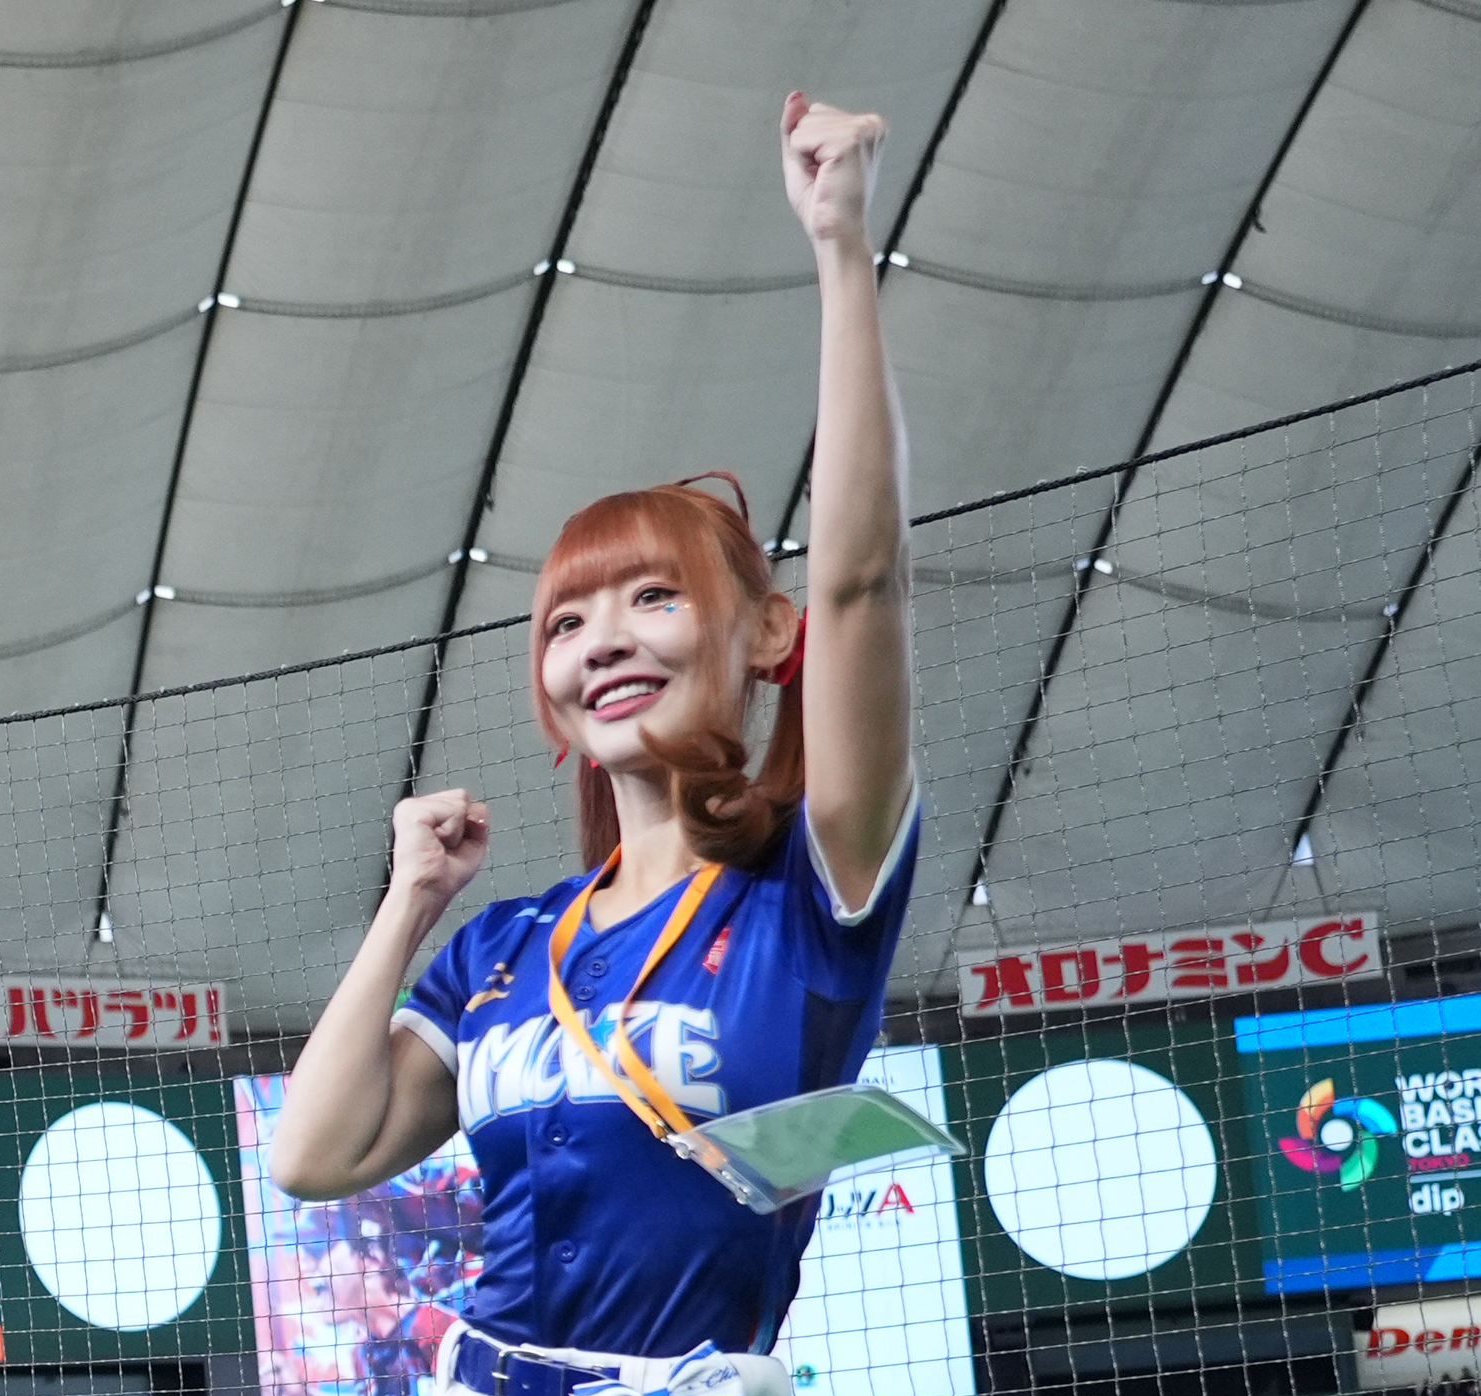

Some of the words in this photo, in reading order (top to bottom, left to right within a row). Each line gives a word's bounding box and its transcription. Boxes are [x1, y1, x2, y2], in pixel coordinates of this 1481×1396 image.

[970, 918, 1369, 1010] オロナミンC
[1400, 1096, 1481, 1130] BAS
[1402, 1125, 1481, 1158] CLA
[1408, 1183, 1465, 1216] dip
